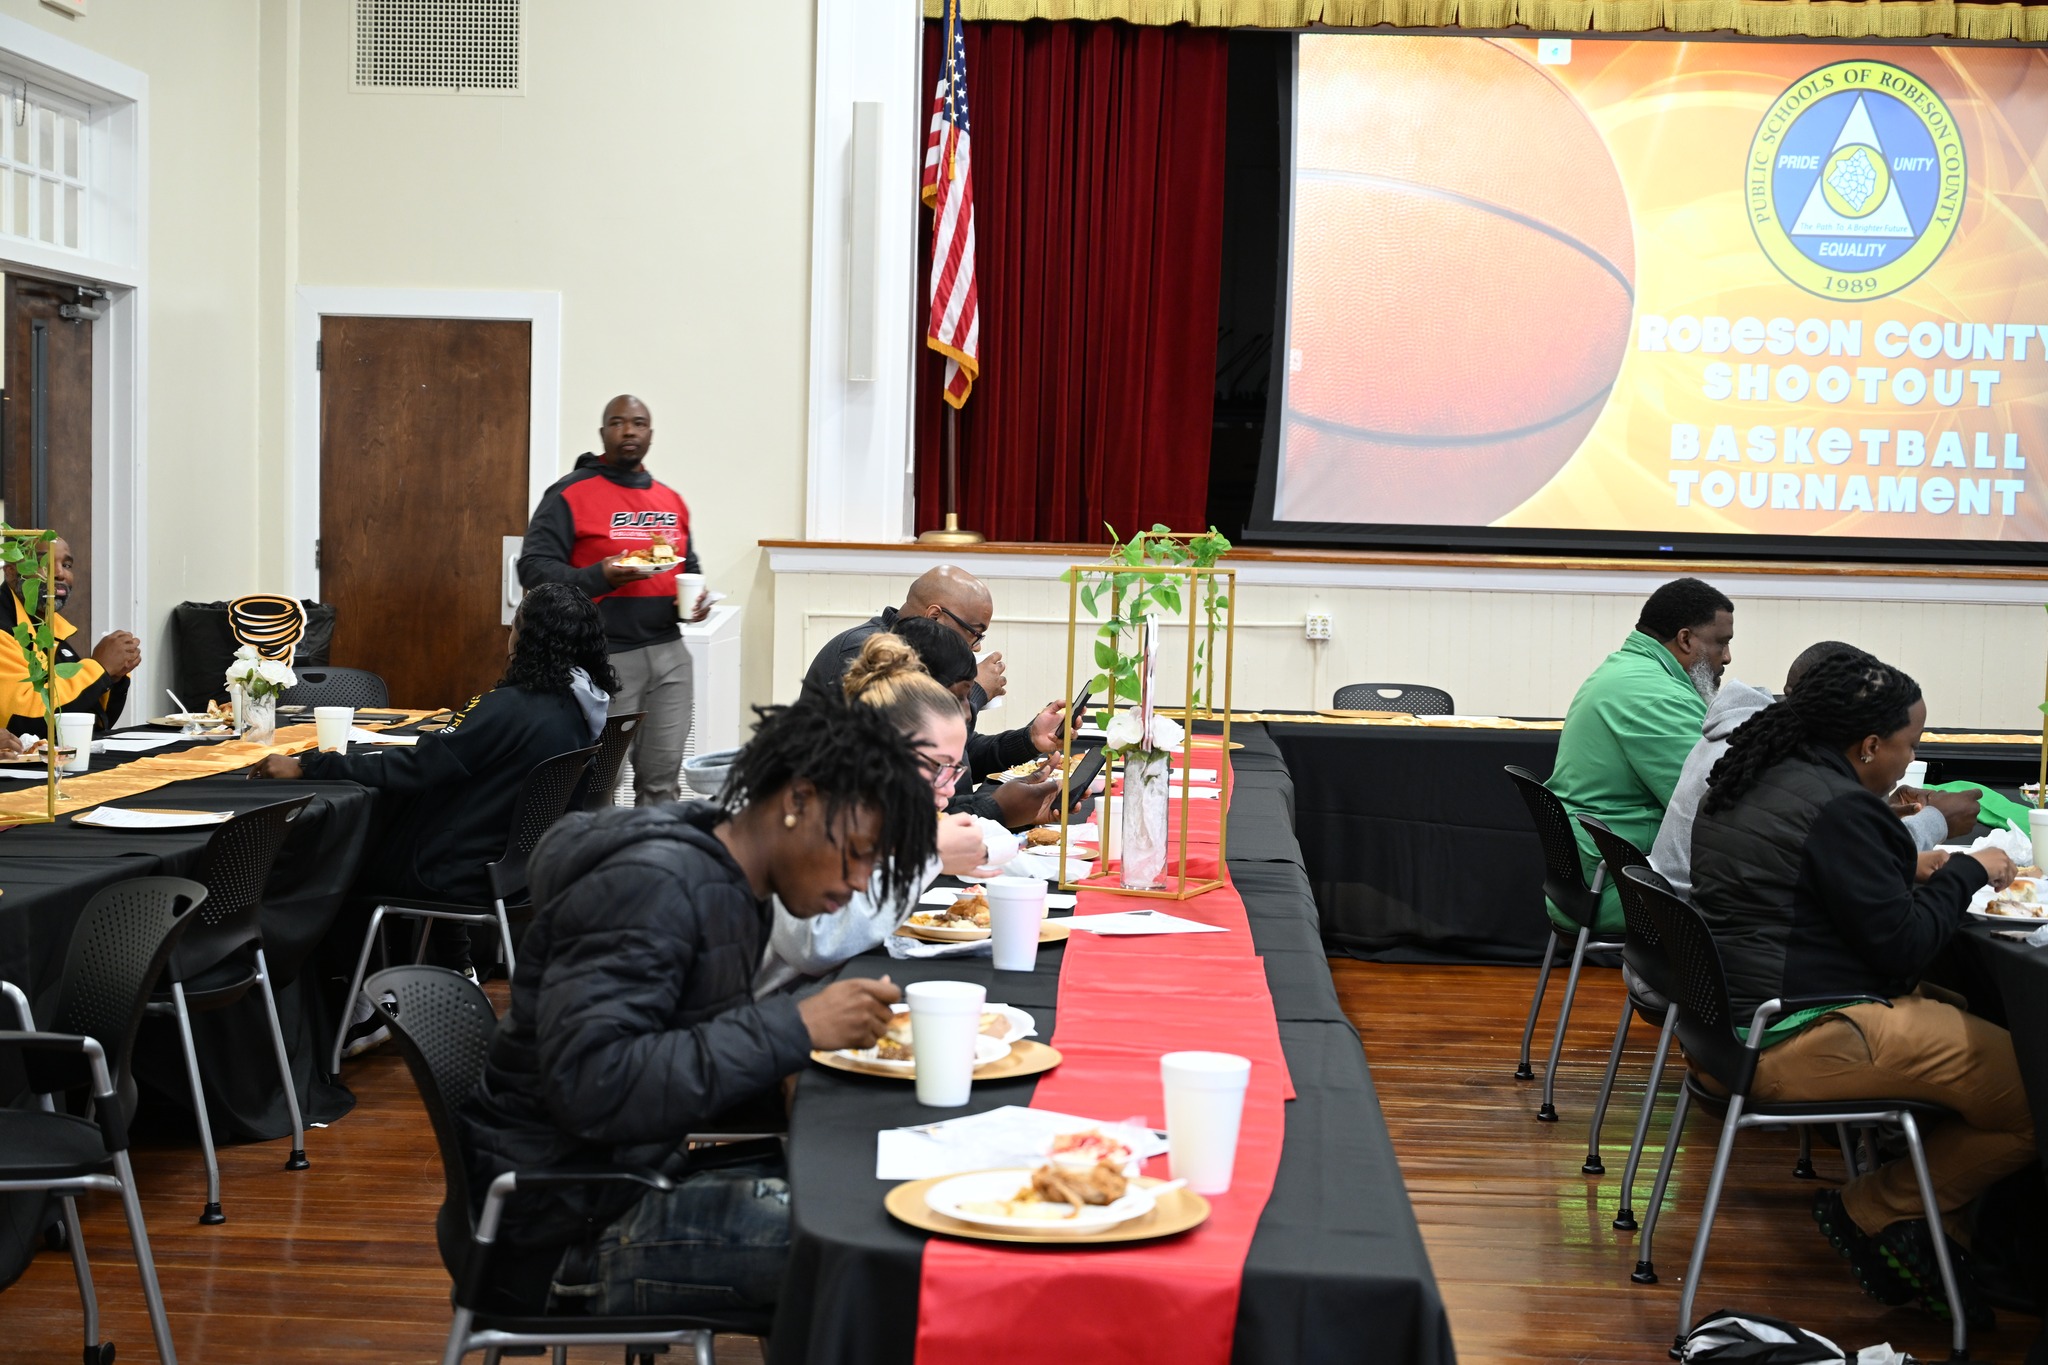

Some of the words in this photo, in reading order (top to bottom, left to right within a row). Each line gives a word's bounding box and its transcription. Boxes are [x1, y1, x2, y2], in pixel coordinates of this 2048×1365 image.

[1752, 152, 1770, 224] PUBLIC
[1762, 73, 1834, 144] SCHOOLS
[1844, 69, 1872, 84] OF
[1879, 71, 1951, 140] ROBESON
[1936, 143, 1961, 228] COUNTY
[1778, 155, 1820, 170] PRIDE
[1894, 157, 1934, 172] UNITY
[1800, 222, 1812, 231] The
[1816, 223, 1833, 231] Path
[1836, 223, 1845, 231] To
[1854, 224, 1883, 233] Brighter
[1885, 224, 1908, 233] Future
[1819, 242, 1887, 257] EQUALITY
[1823, 276, 1878, 294] 1989
[1702, 363, 2000, 407] SHOOTOUT
[610, 511, 678, 528] BUCKS
